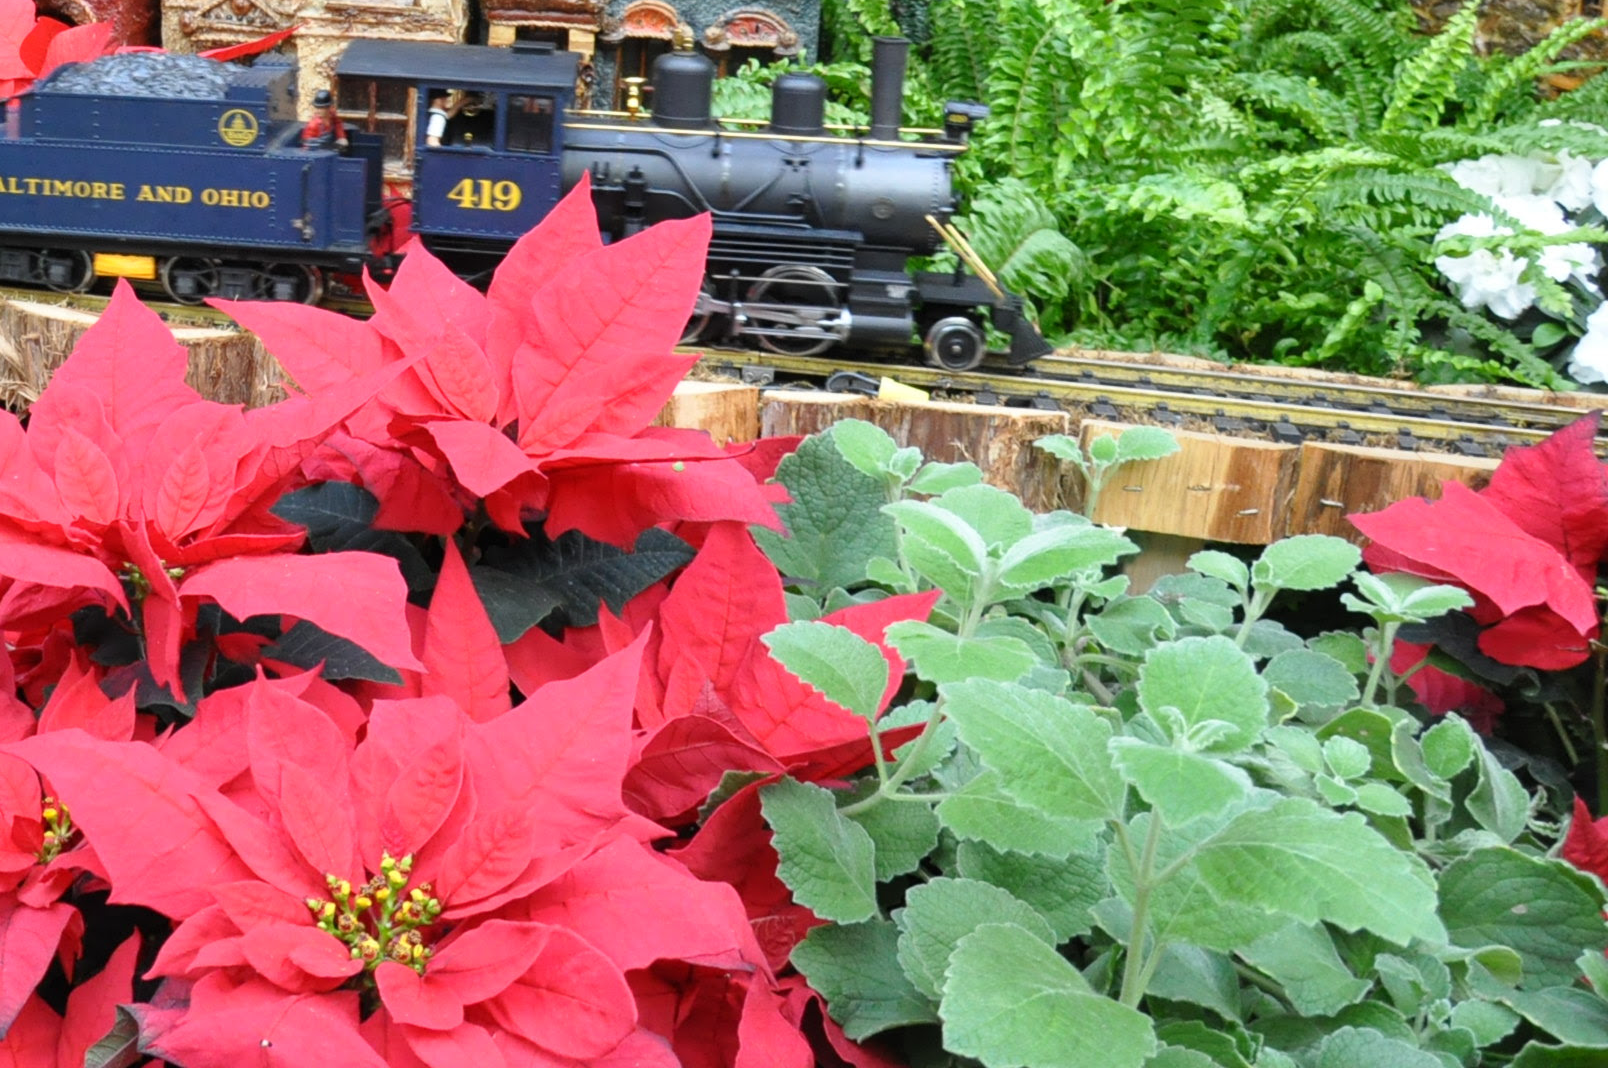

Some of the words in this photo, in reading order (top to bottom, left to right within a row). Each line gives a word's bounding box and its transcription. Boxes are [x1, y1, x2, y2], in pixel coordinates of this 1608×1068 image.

[137, 183, 193, 205] AND
[200, 187, 271, 209] OHIO
[447, 178, 523, 212] 419
